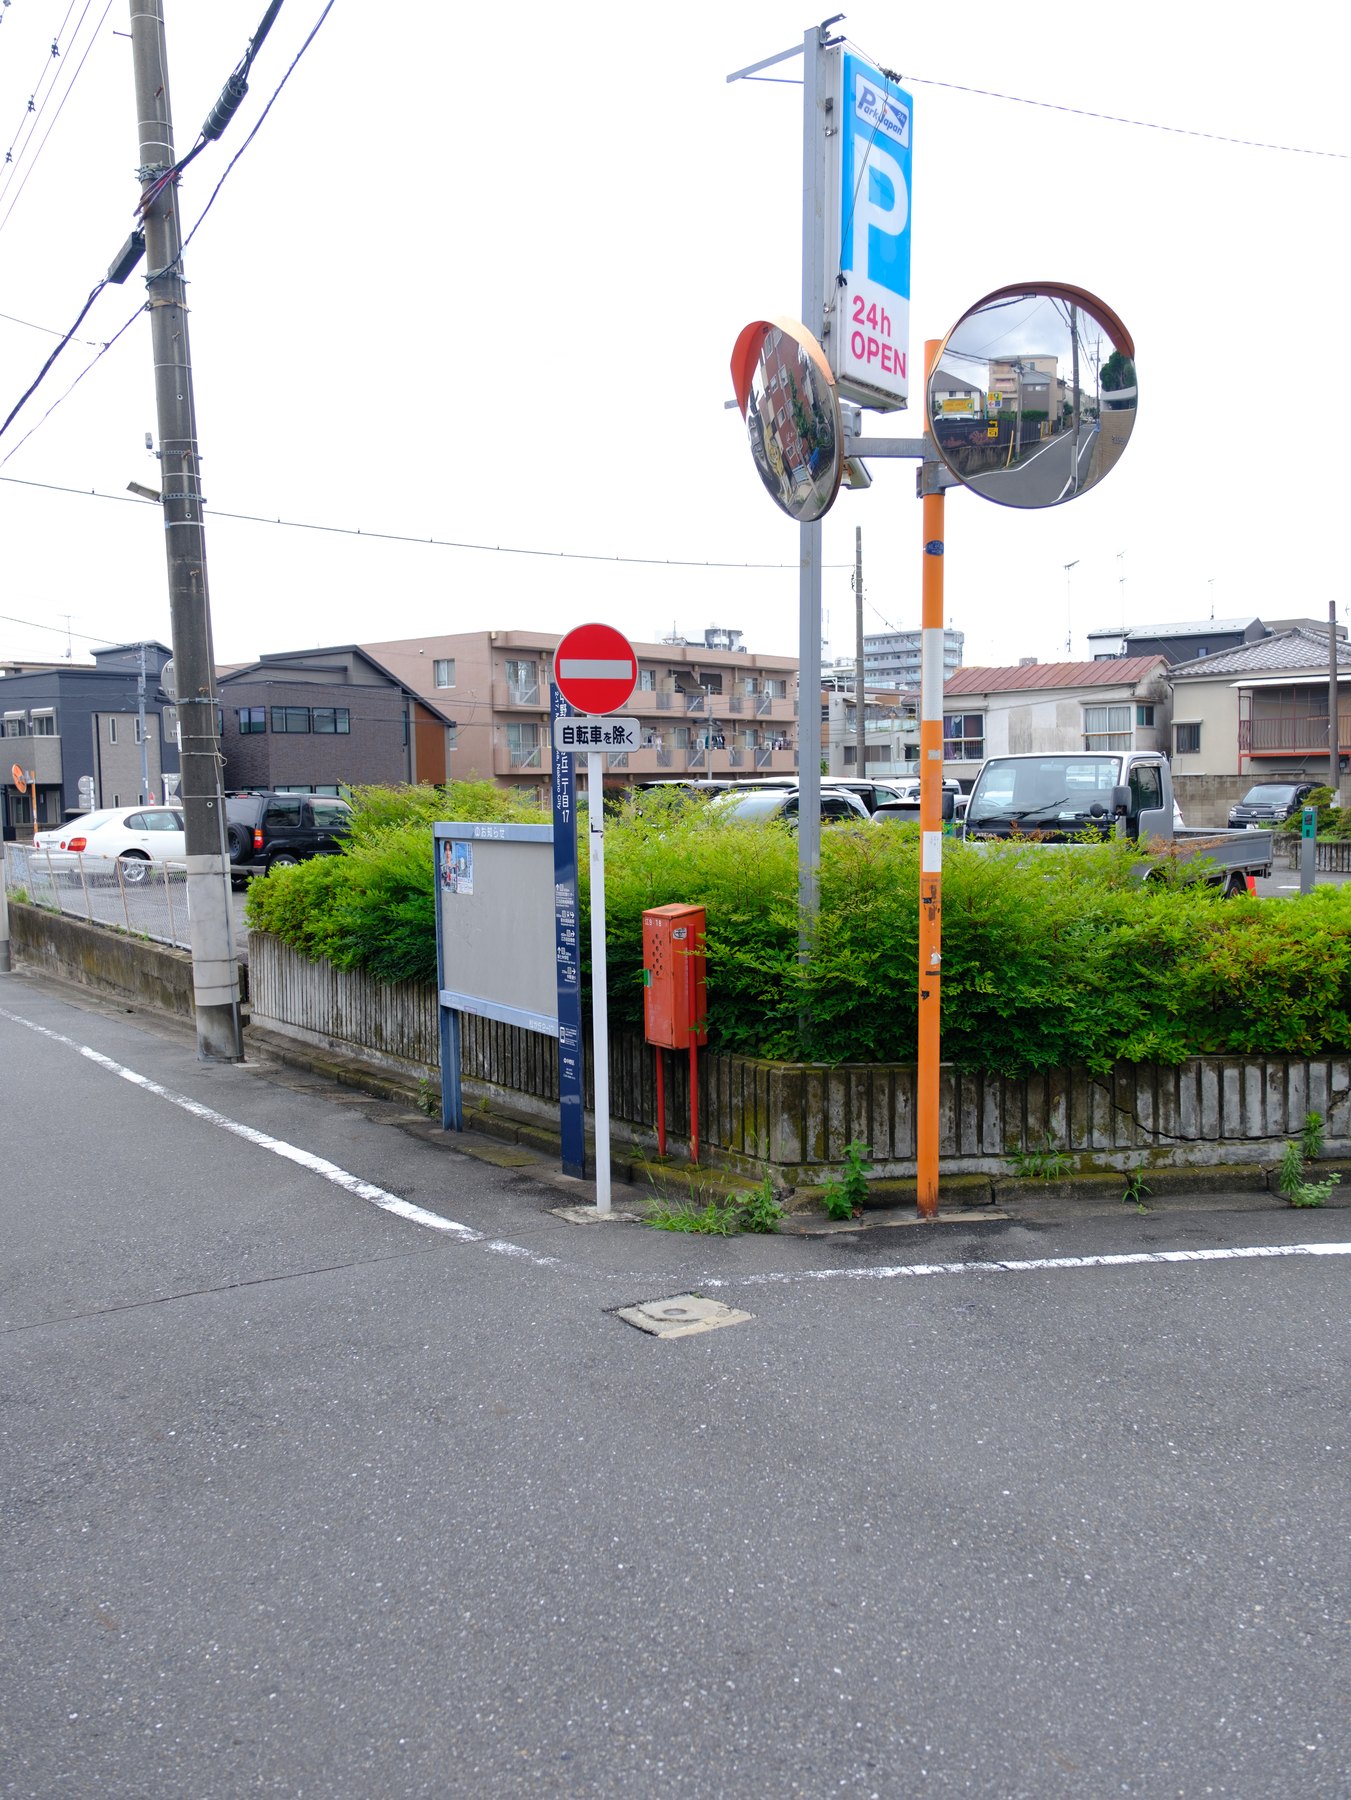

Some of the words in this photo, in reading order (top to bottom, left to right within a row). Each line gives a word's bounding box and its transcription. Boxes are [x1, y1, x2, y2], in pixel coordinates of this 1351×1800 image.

[853, 133, 908, 280] P
[852, 295, 891, 337] 24h
[850, 330, 906, 380] OPEN
[562, 725, 634, 745] 自転車を除く
[480, 827, 505, 839] お知らせ
